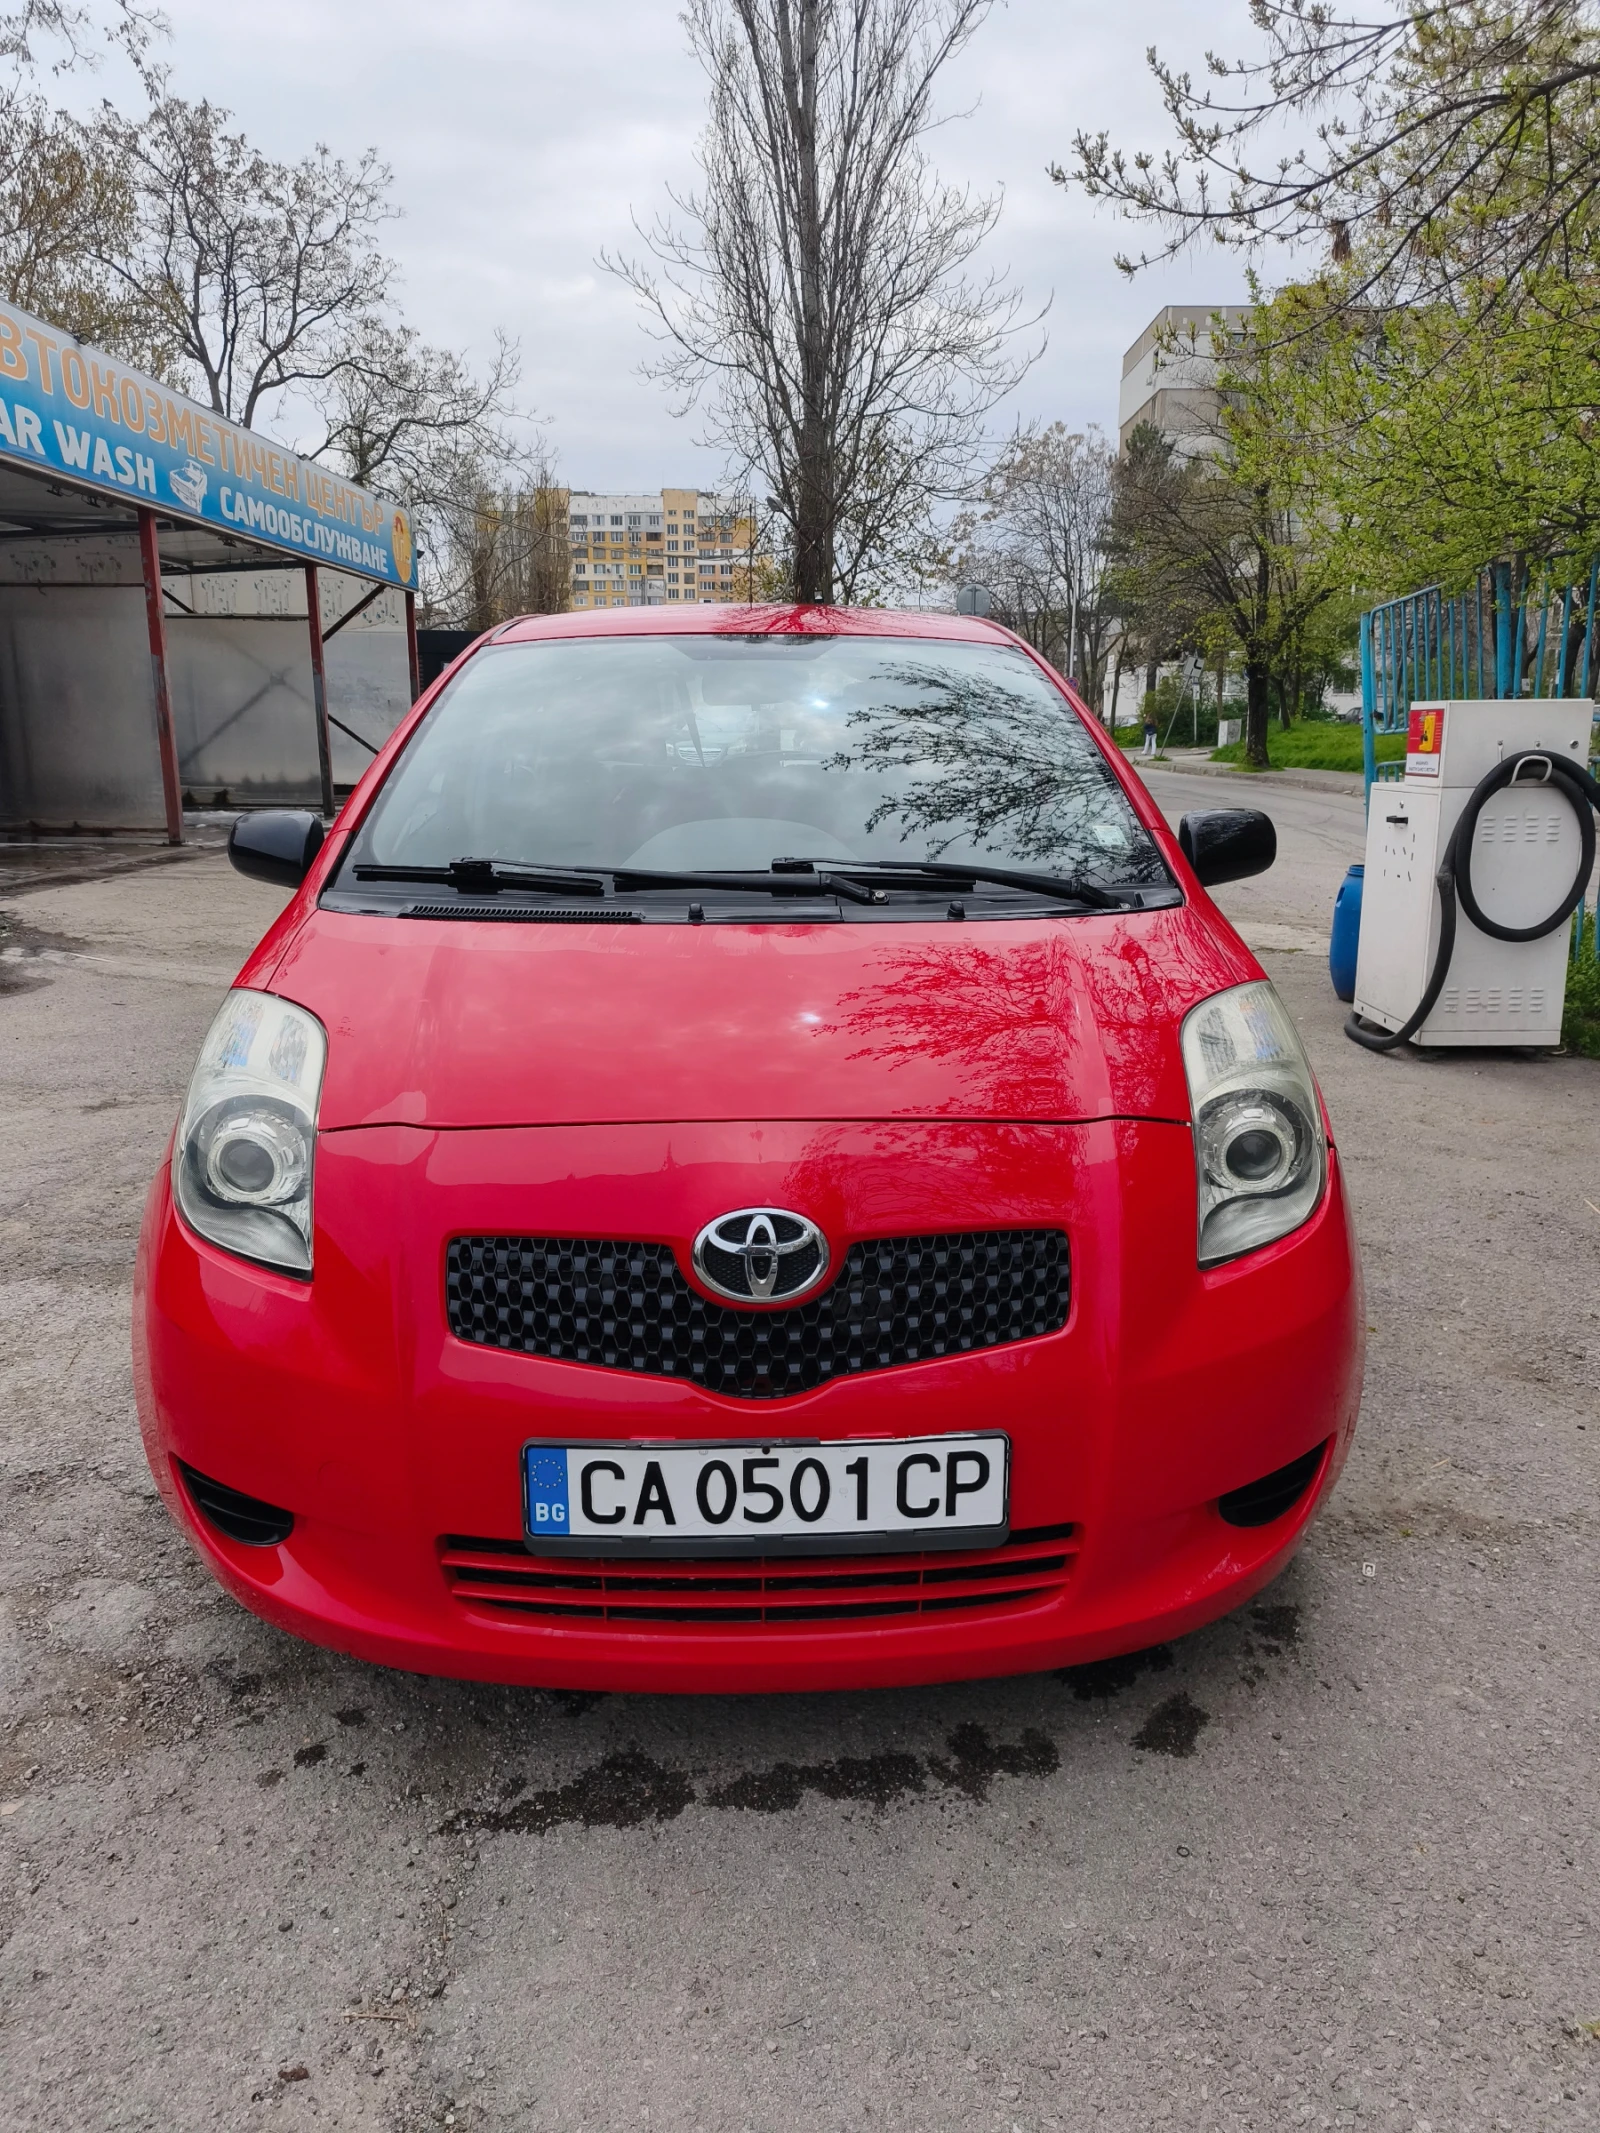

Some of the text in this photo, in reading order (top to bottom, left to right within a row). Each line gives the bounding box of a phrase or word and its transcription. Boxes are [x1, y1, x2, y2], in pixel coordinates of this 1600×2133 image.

[52, 419, 157, 494] WASH
[219, 486, 389, 574] САМООБСЛУЖВАНЕ
[305, 468, 385, 536] ЦЕНТЪР
[535, 1502, 566, 1522] BG
[580, 1450, 990, 1525] CA 0501 CP
